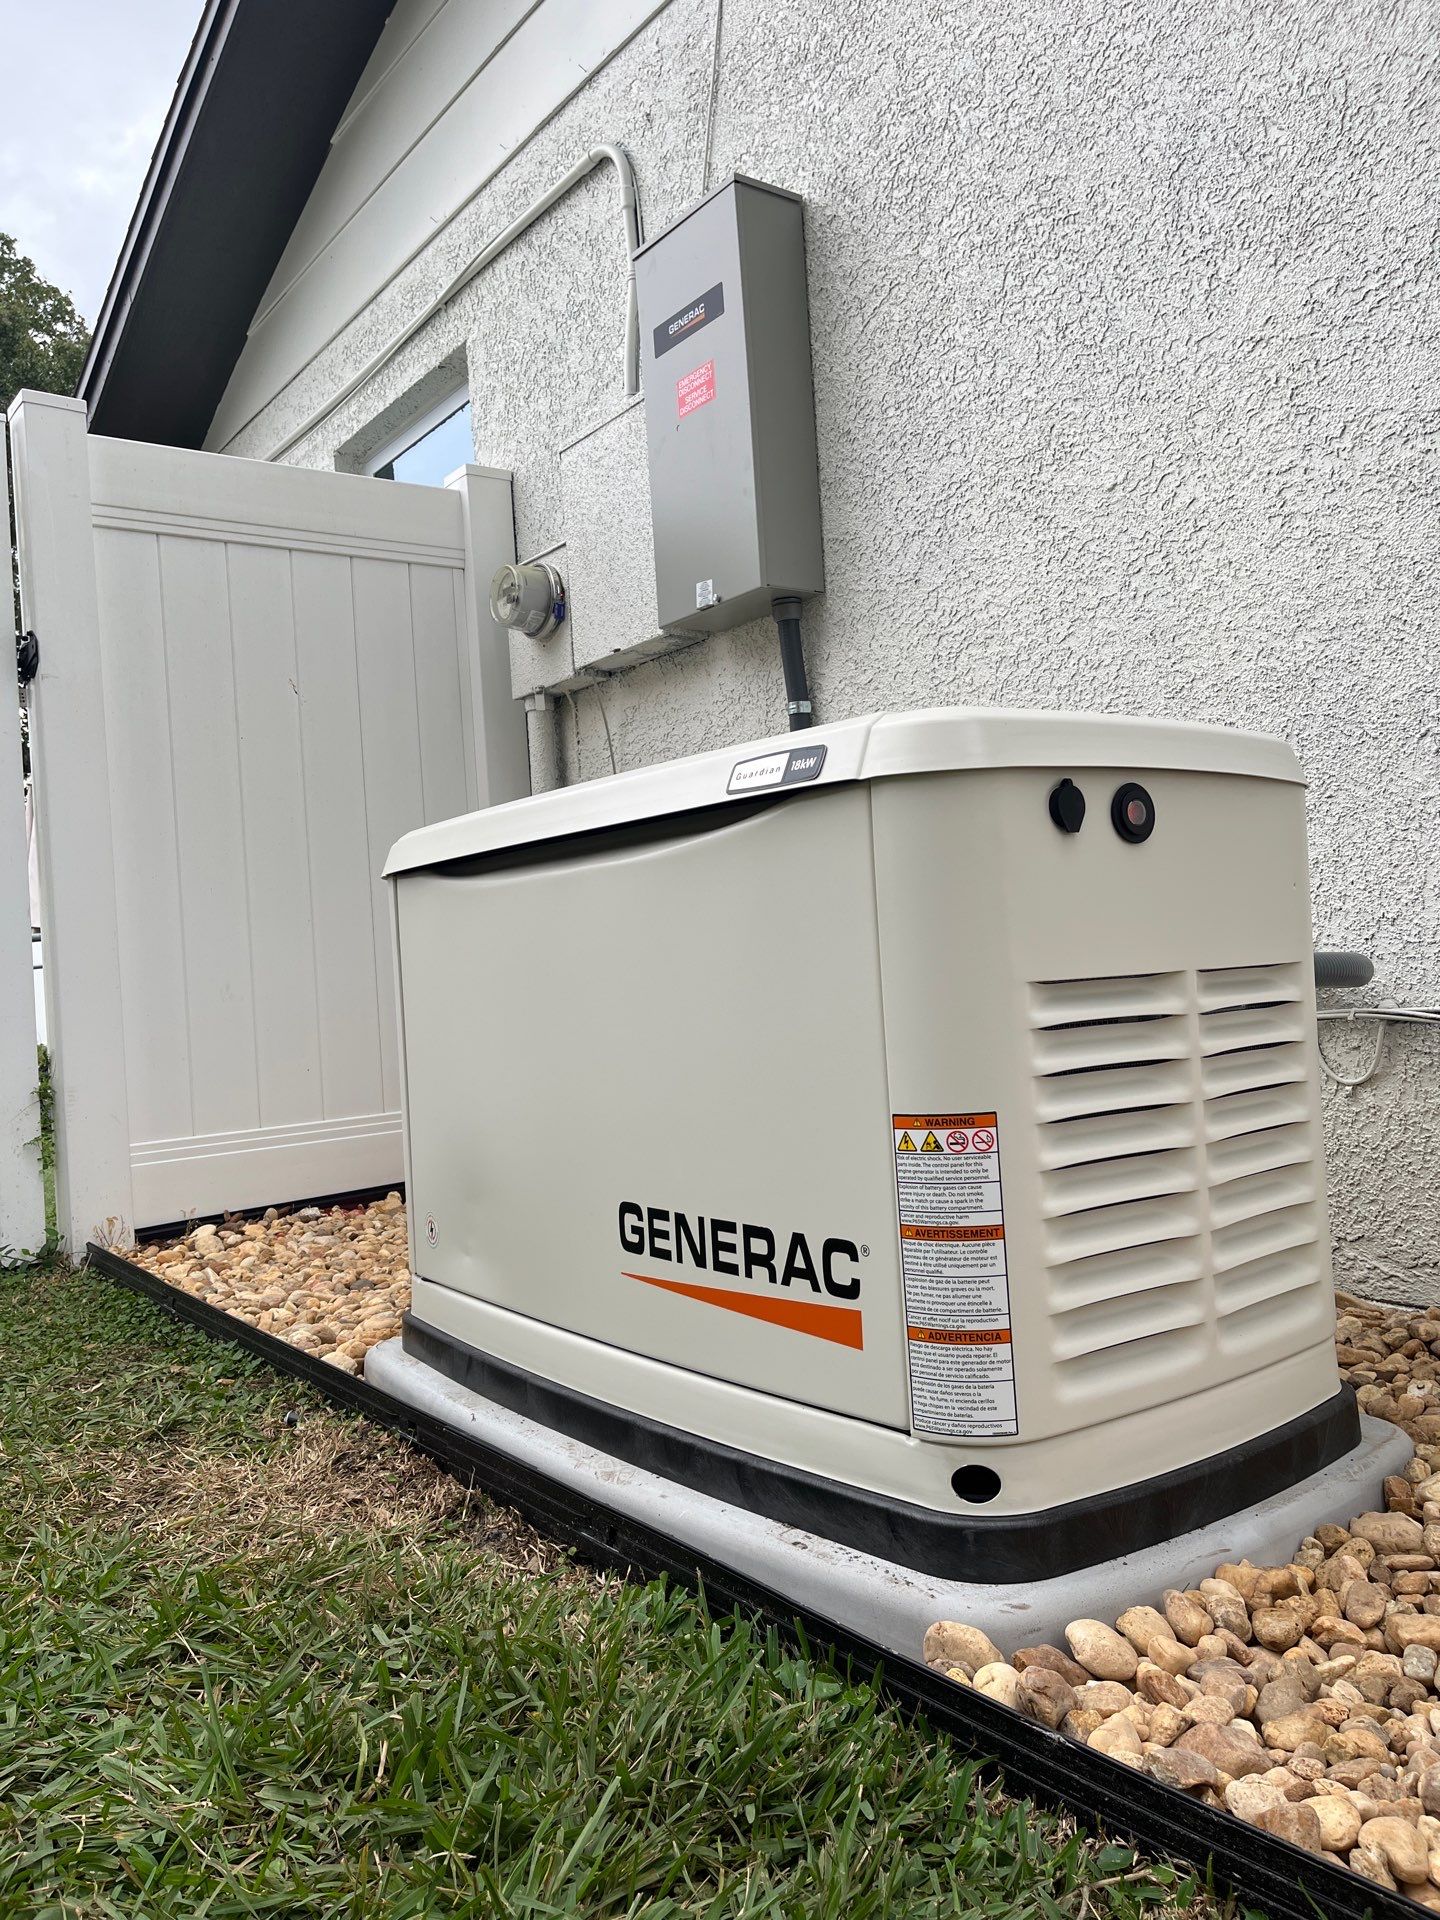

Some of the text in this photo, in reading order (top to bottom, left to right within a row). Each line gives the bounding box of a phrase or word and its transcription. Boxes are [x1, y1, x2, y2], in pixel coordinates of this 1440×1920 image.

[668, 303, 705, 335] GENERAC
[678, 362, 712, 388] EMERGENCY
[679, 371, 712, 397] DISCONNECT
[679, 389, 714, 416] DISCONNECT
[685, 386, 707, 404] SERVICE
[736, 757, 817, 780] Guardian 18kW
[925, 1118, 975, 1126] WARNING
[915, 1229, 999, 1238] AVERTISSEMENT
[928, 1333, 1001, 1342] ADVERTENCIA
